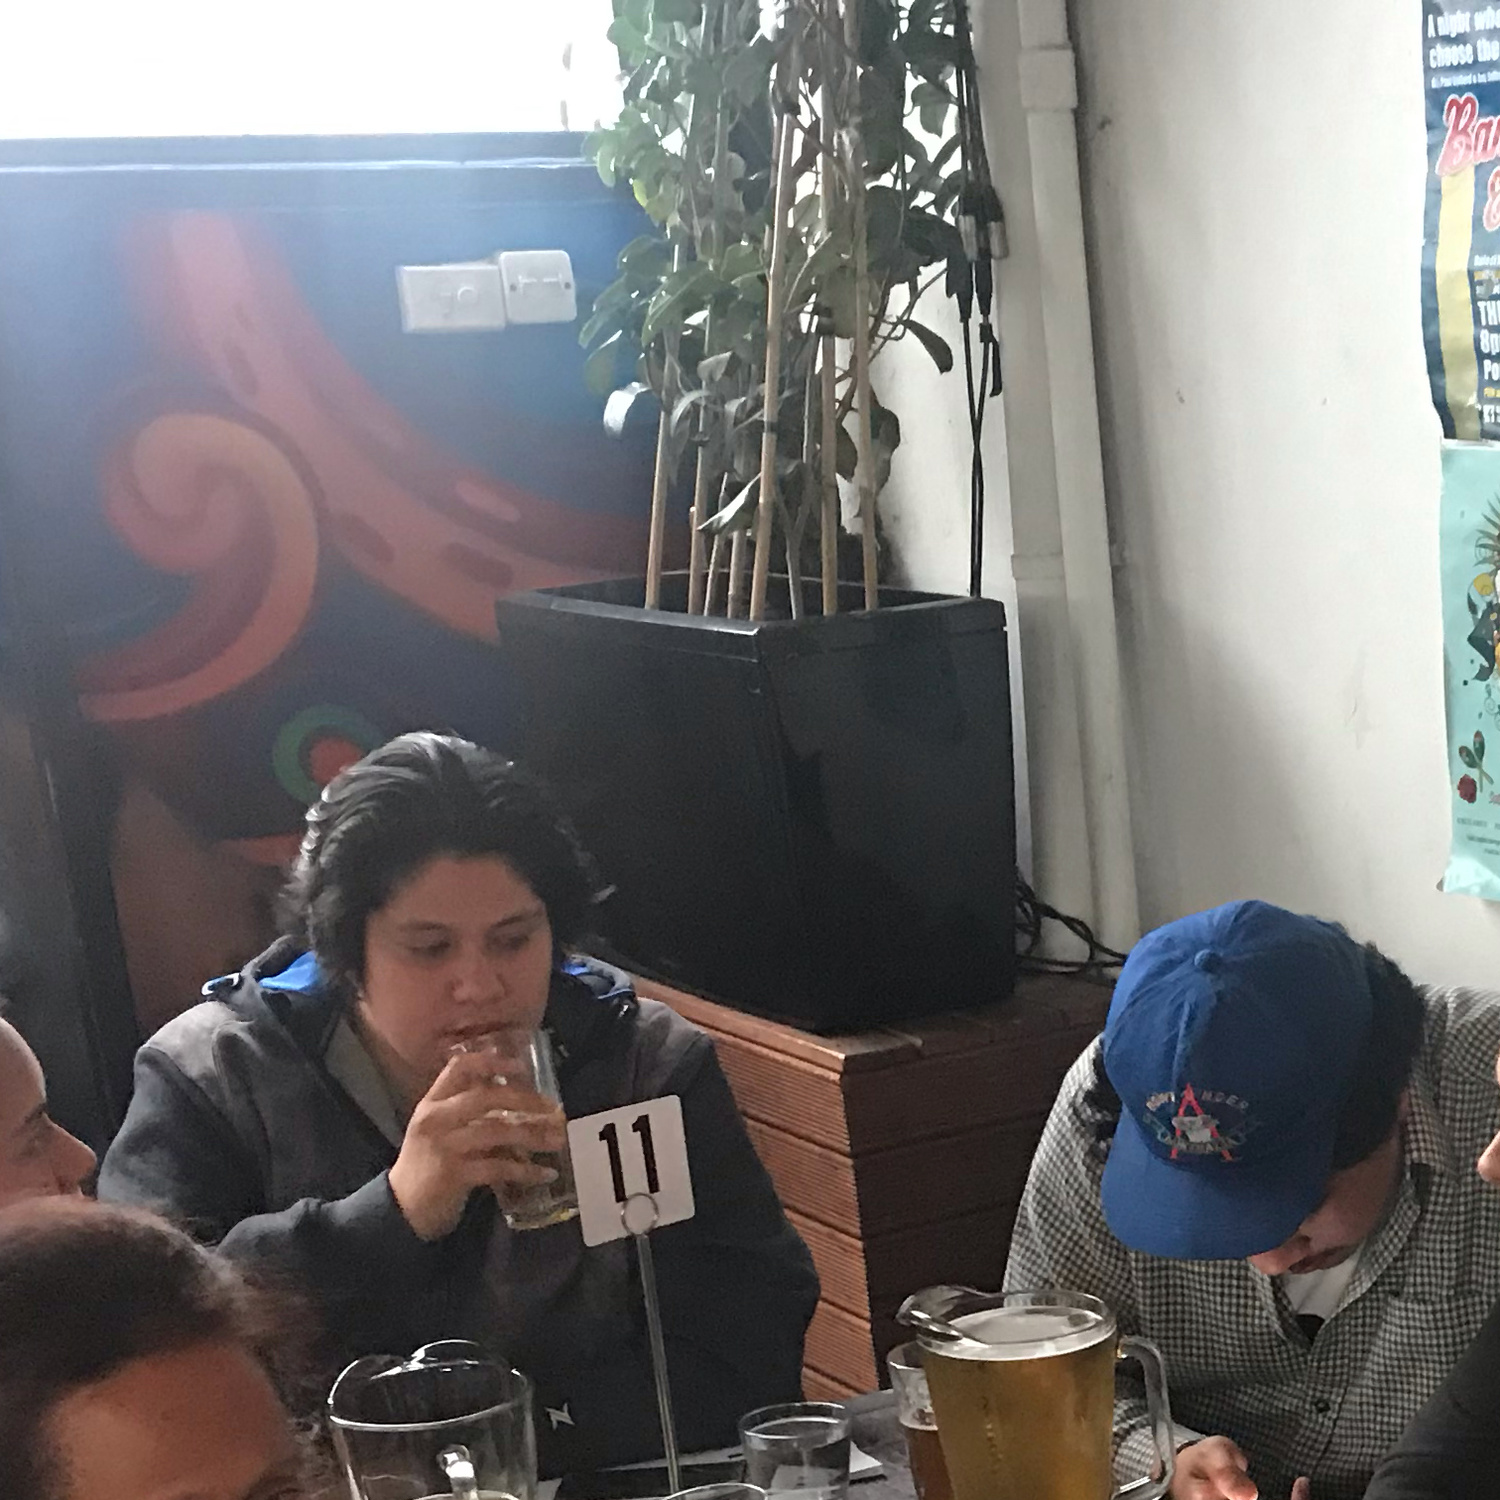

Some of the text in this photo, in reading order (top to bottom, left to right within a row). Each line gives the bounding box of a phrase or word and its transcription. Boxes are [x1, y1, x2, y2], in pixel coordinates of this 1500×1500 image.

[1428, 14, 1436, 38] A
[1429, 43, 1473, 68] choose
[1477, 38, 1500, 62] the
[598, 1113, 661, 1204] 11
